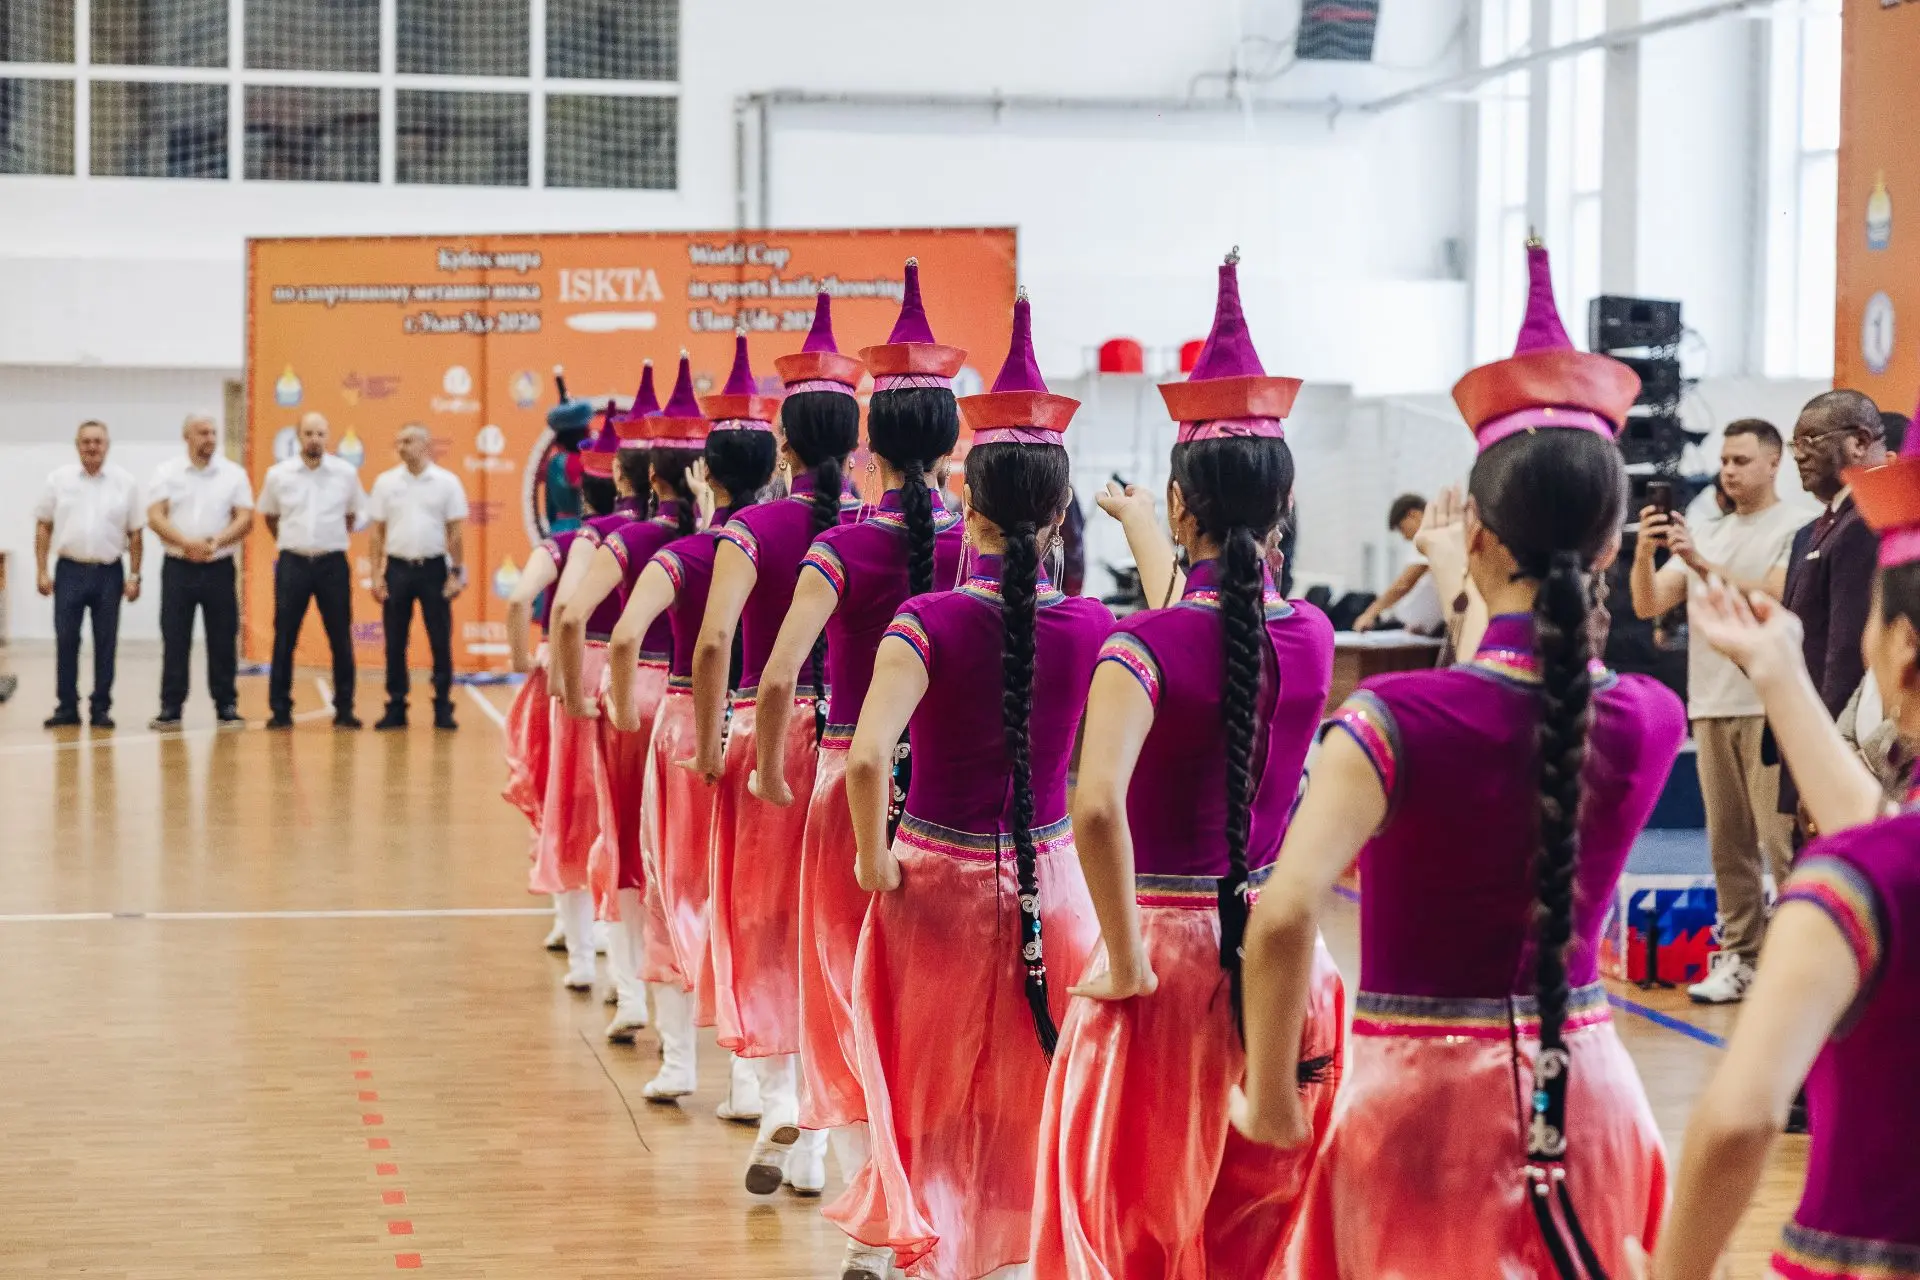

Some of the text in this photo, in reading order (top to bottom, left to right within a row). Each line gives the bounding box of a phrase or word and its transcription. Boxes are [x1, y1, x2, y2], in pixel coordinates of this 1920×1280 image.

[688, 243, 790, 270] World Cup
[558, 268, 664, 302] ISKTA
[688, 277, 708, 298] in
[710, 280, 768, 304] sports
[769, 275, 818, 297] knife
[781, 309, 817, 331] 202
